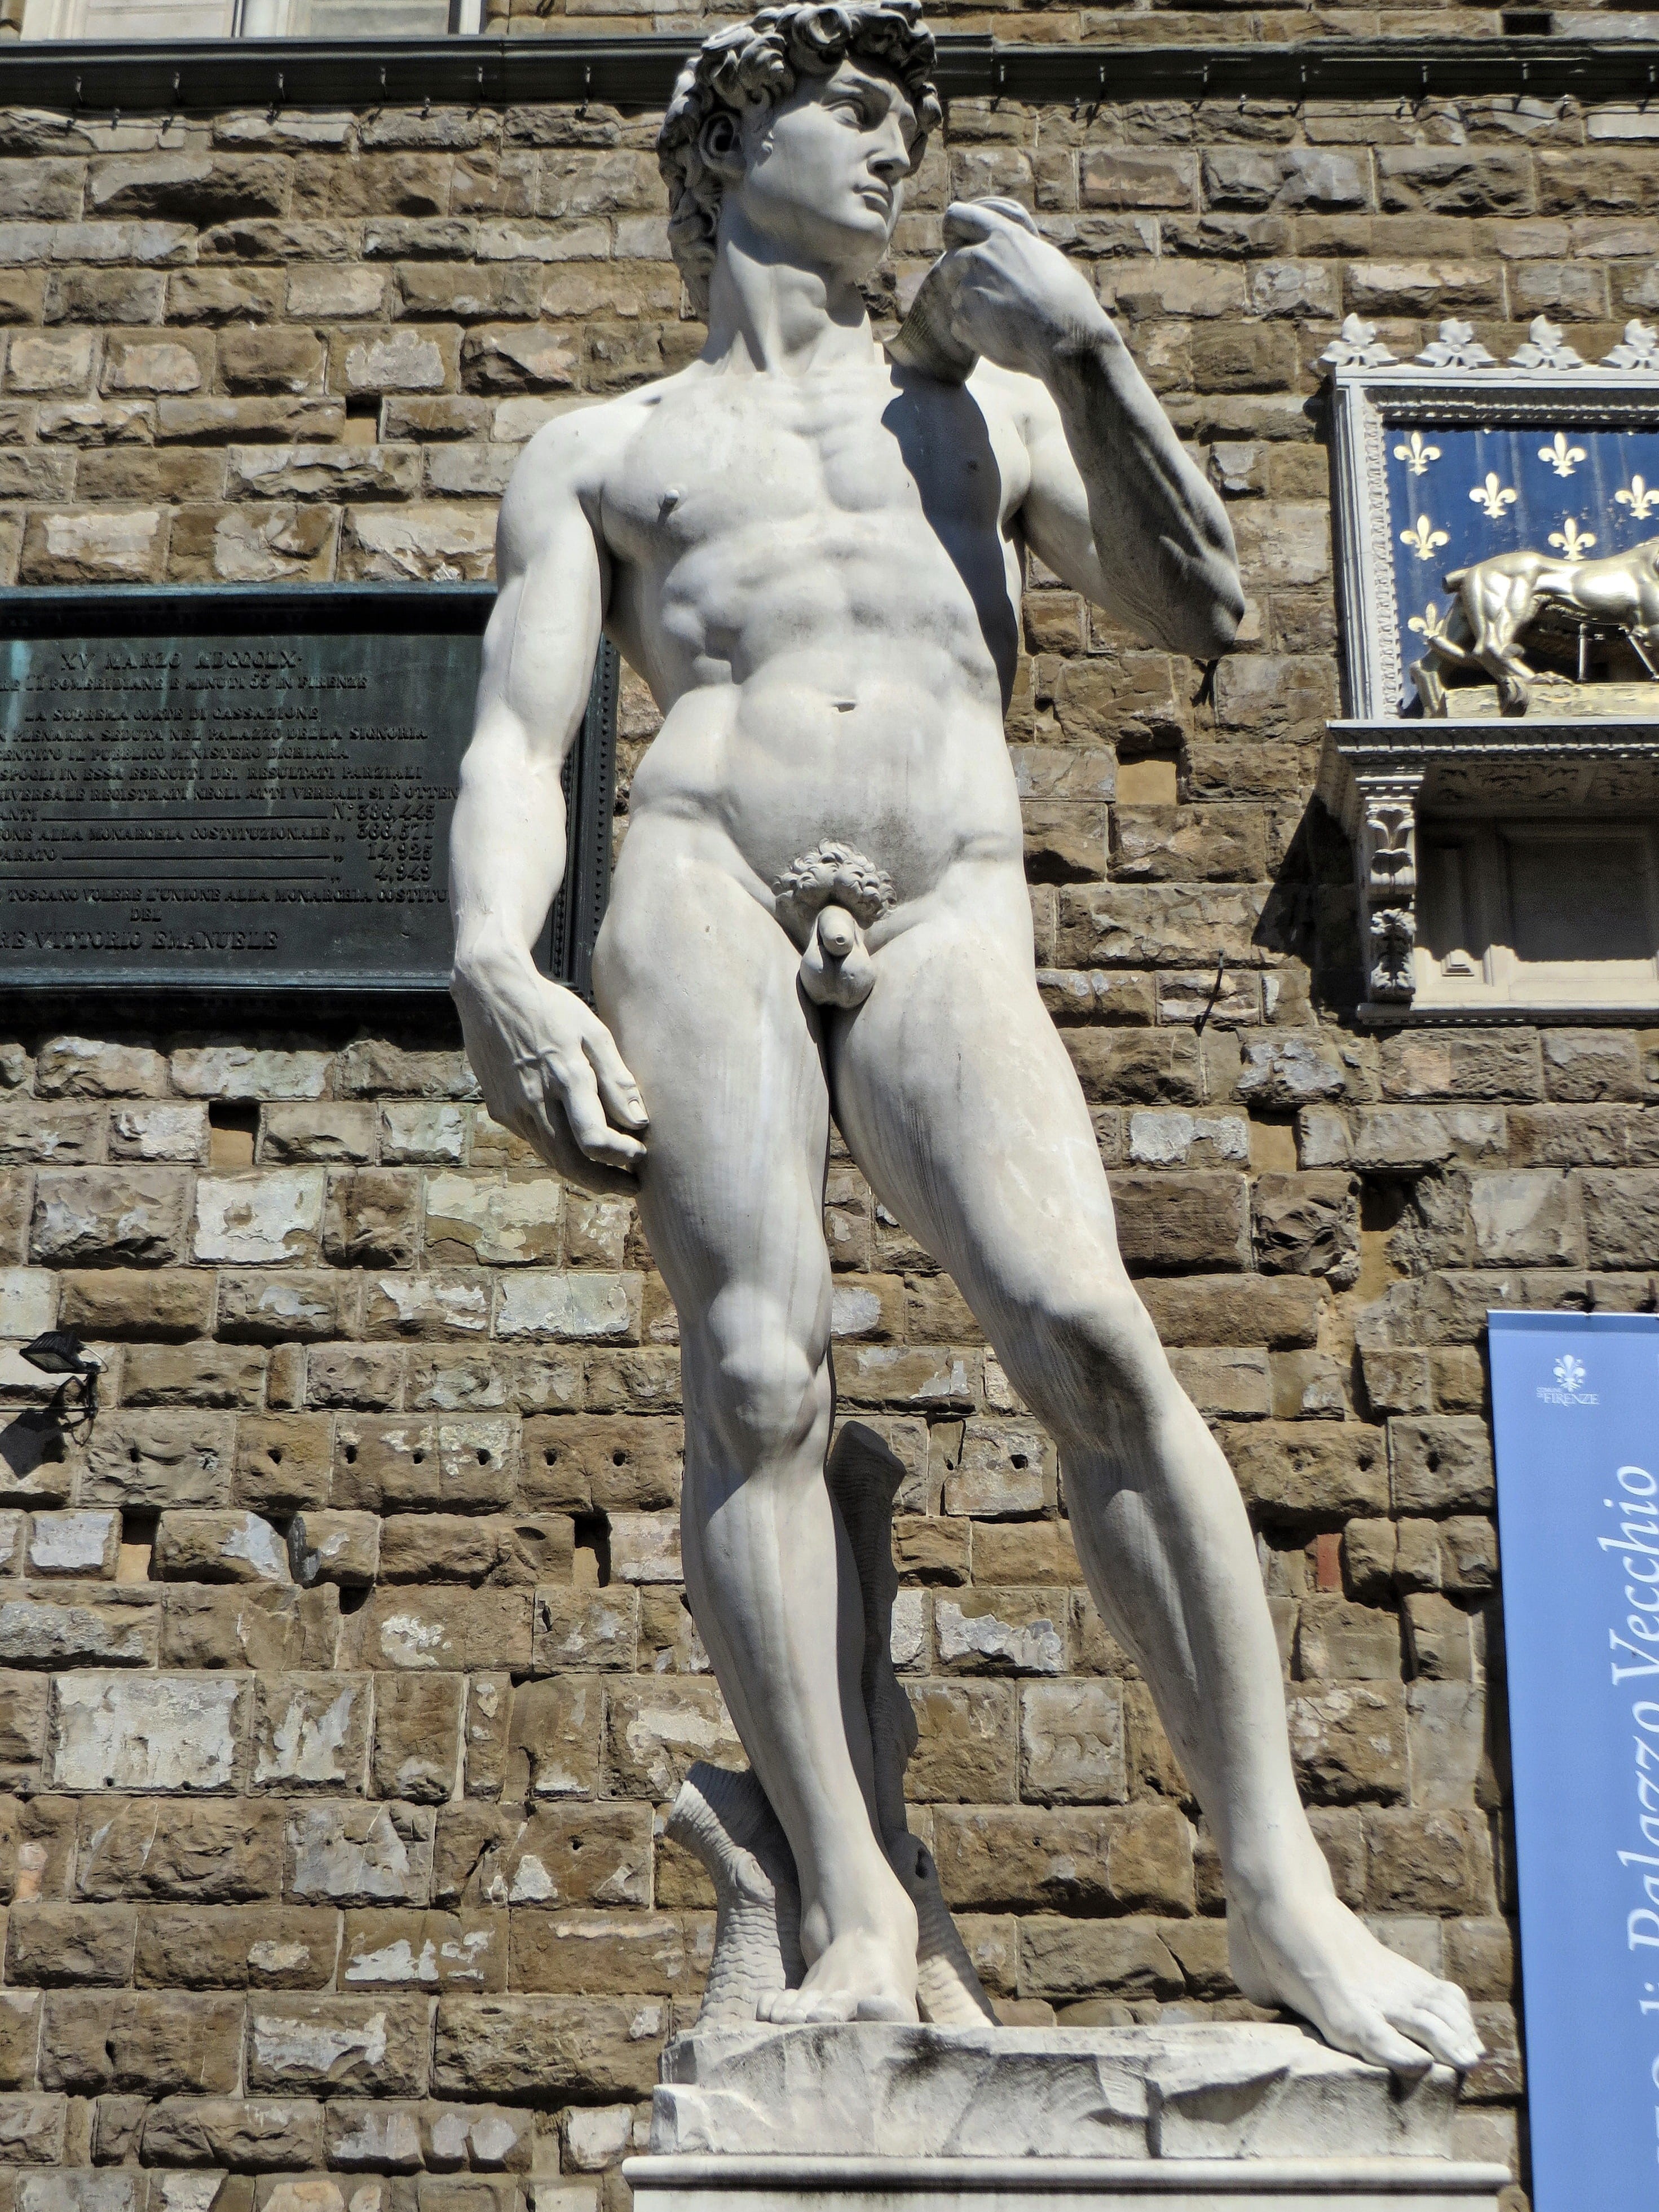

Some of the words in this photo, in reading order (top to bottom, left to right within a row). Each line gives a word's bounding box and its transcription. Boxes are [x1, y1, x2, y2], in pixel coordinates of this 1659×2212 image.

[105, 651, 182, 670] MARZO
[48, 678, 164, 691] POMERIDIANE
[185, 677, 245, 690] MINUTI
[249, 673, 271, 689] 55
[275, 676, 293, 689] IN
[298, 676, 368, 689] FIRENZE
[24, 709, 47, 722] LA
[52, 708, 129, 722] SUPREMA
[133, 708, 184, 721] CORTE
[189, 707, 206, 721] DI
[212, 706, 319, 720] CASSAZIONE
[12, 730, 95, 742] PLENARIA
[100, 729, 164, 742] SEDUTA
[169, 728, 201, 742] NEL
[208, 728, 281, 741] PALAZZO
[286, 727, 343, 740] DELLA
[349, 726, 429, 739] SIGNORIA
[0, 748, 62, 761] ENTITO
[68, 748, 86, 761] IL
[90, 748, 166, 761] PUBBLICO
[171, 747, 262, 760] MINISTERO
[267, 746, 349, 759] DICHIARA
[59, 768, 78, 781] IN
[83, 768, 123, 781] ESSA
[129, 768, 205, 780] ESEGUITI
[209, 766, 239, 780] DEI
[246, 766, 336, 780] RESULTATI
[342, 766, 423, 779] PARZIALI
[0, 788, 86, 801] IVERSALE
[90, 788, 187, 801] REGISTRATI
[193, 787, 241, 801] NEGLI
[245, 787, 286, 800] ATTI
[292, 787, 364, 800] VERBALI
[368, 787, 385, 800] SI
[38, 826, 84, 841] ALLA
[88, 826, 185, 841] MONARCHIA
[190, 826, 331, 841] COSTITUZIONALE
[0, 848, 58, 861] ARATO
[373, 863, 433, 884] 4,949
[8, 888, 80, 902] TOSCANO
[82, 888, 142, 902] VOLERE
[224, 888, 271, 902] ALLA
[274, 888, 374, 902] MONARCHIA
[376, 889, 449, 903] COSTITU
[129, 907, 162, 922] DEL
[34, 930, 143, 950] VITTORIO
[151, 929, 279, 950] EMANUELE
[1543, 1393, 1601, 1407] FIRENZE
[1596, 1465, 1659, 1685] Vecchio
